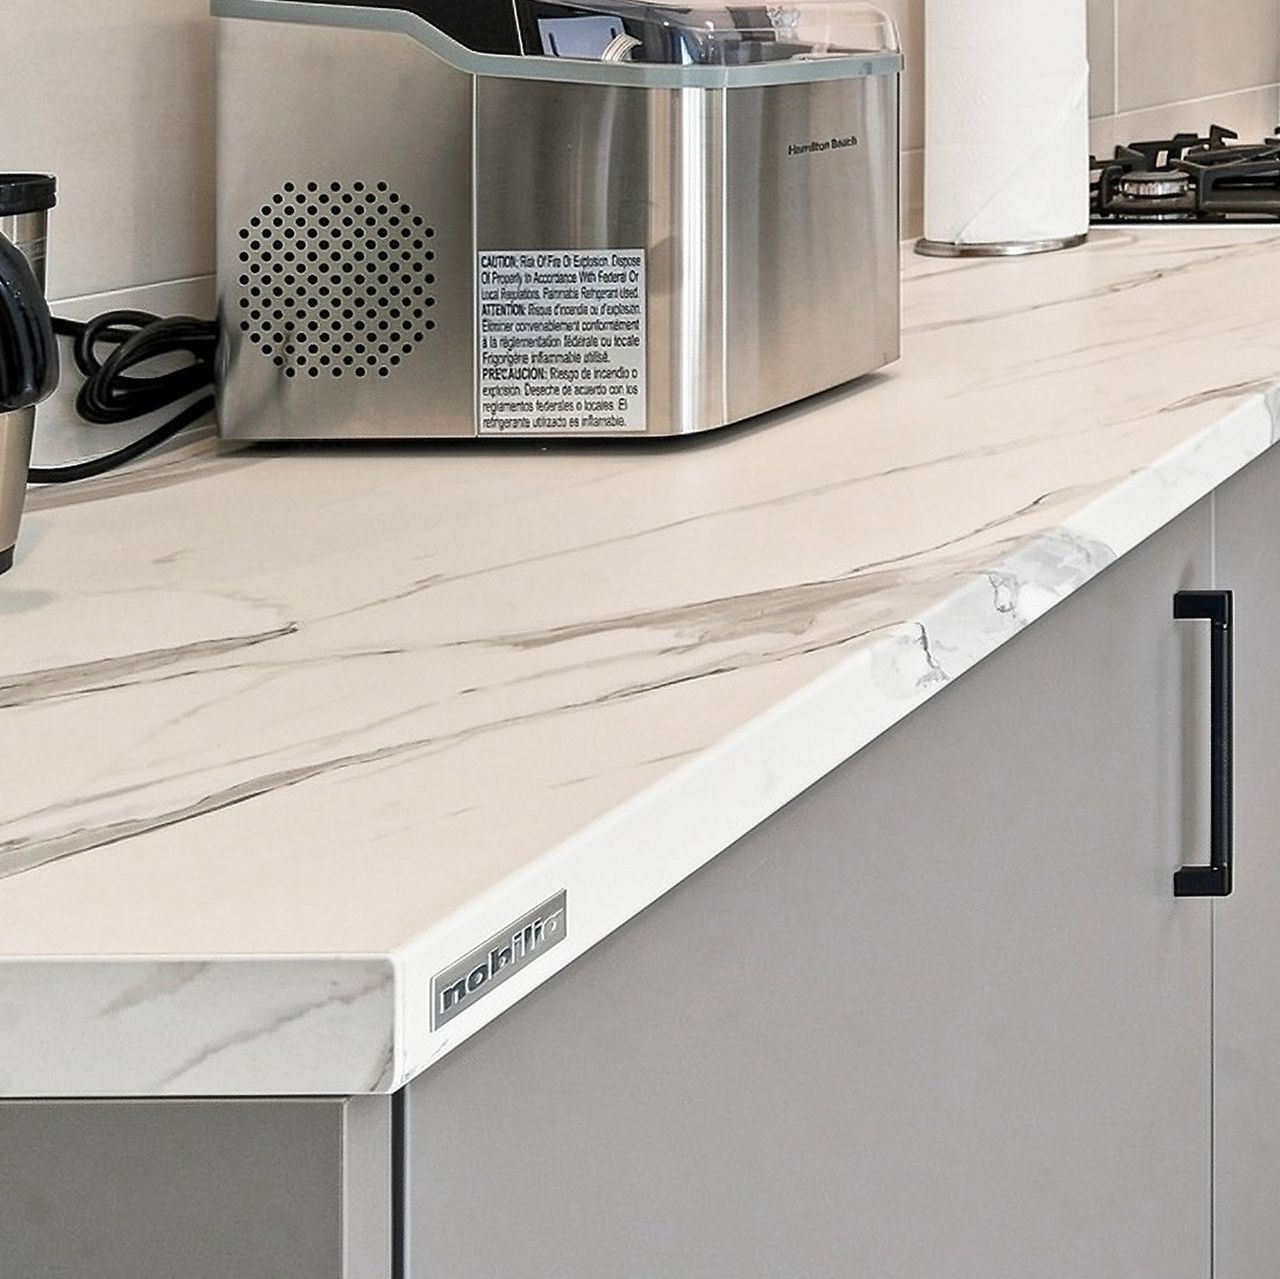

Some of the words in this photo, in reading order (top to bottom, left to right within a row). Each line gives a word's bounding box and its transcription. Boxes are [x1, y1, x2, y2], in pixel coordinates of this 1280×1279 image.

[788, 141, 830, 155] Hamilton
[831, 136, 858, 148] Beach
[612, 255, 641, 269] Dispose
[534, 272, 577, 283] Accordance
[579, 271, 596, 283] With
[598, 270, 627, 282] Federal
[629, 270, 639, 283] Or
[601, 337, 611, 347] ou
[550, 368, 579, 382] Riesgo
[581, 368, 591, 379] de
[594, 367, 628, 379] incendio
[632, 370, 638, 379] o
[524, 383, 560, 396] Deseche
[562, 384, 572, 395] de
[609, 385, 624, 394] con
[576, 402, 582, 411] o
[619, 399, 627, 411] El
[569, 417, 579, 427] es
